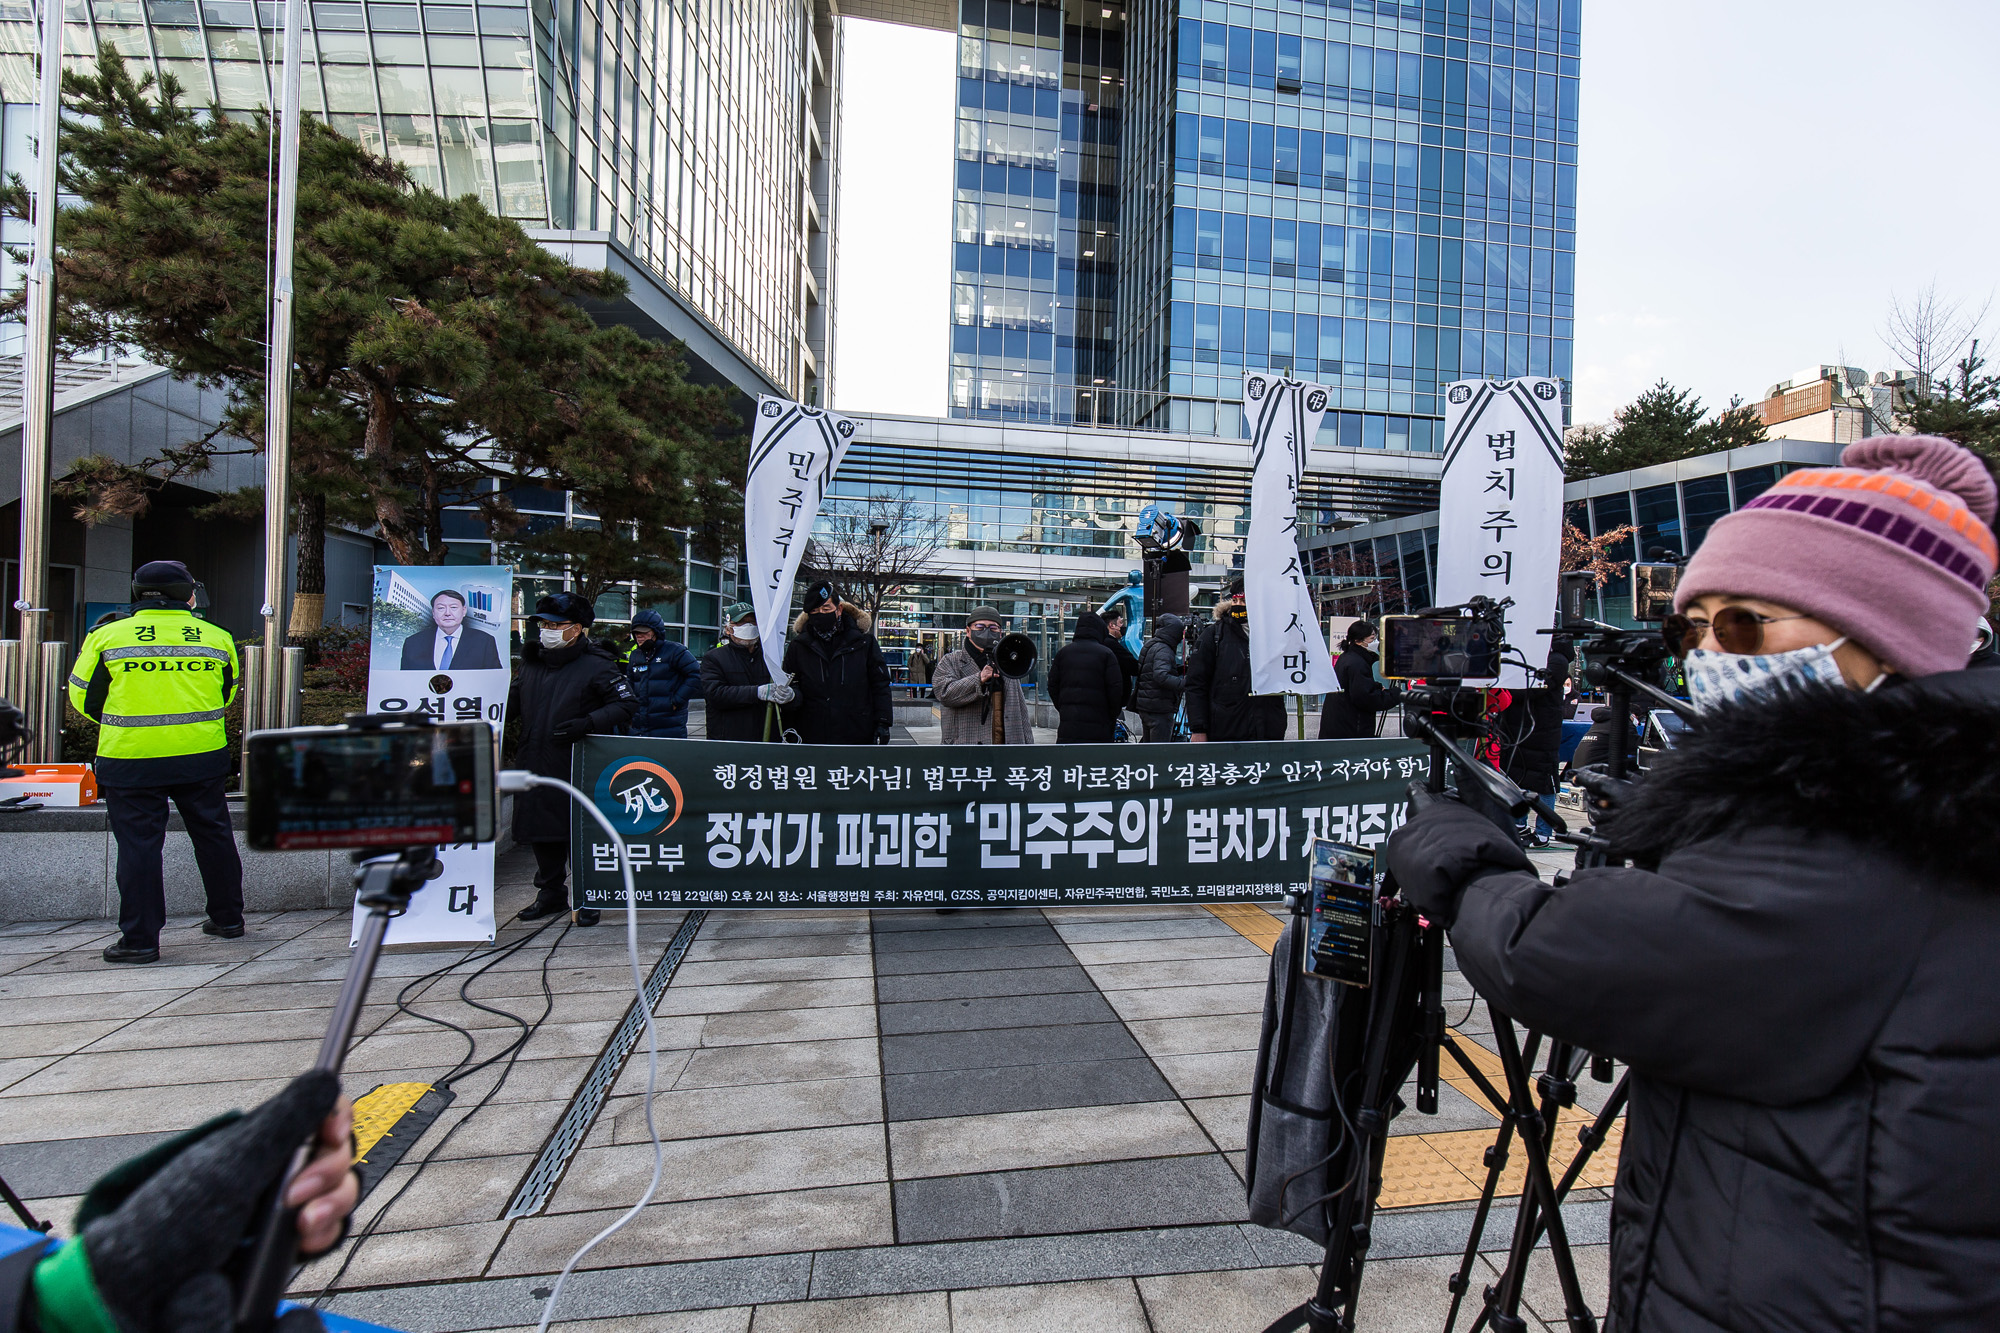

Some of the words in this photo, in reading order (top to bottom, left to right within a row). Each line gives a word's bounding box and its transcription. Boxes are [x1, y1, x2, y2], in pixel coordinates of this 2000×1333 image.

[1479, 430, 1518, 586] 법치주의
[134, 625, 203, 643] 경찰
[123, 660, 216, 673] POLICE
[712, 763, 817, 791] 행정법원
[827, 765, 912, 792] 판사님!
[923, 766, 997, 792] 법무부
[1004, 765, 1053, 792] 폭정
[1062, 763, 1159, 791] 바로잡아
[1281, 760, 1323, 783] 임기
[1330, 757, 1392, 782] 지켜야
[1396, 754, 1454, 780] 합니.
[706, 811, 824, 869] 정치가
[835, 811, 952, 868] 파괴한
[1186, 806, 1291, 864] 법치가
[592, 843, 685, 873] 법무부
[585, 889, 611, 901] 일시:
[657, 890, 682, 902] 12월
[684, 890, 728, 902] 22일(화)
[731, 890, 753, 902] 오후
[755, 890, 774, 902] 2시
[777, 890, 803, 903] 장소:
[806, 890, 870, 903] 서울행정법원
[874, 890, 899, 902] 주최:
[902, 889, 948, 902] 자유연대,
[951, 889, 984, 902] GZSS,
[986, 888, 1062, 901] 공익지킴이센터,
[1064, 886, 1148, 900] 자유민주국민연합,
[1150, 885, 1194, 899] 국민노조,
[1288, 882, 1311, 892] 국민
